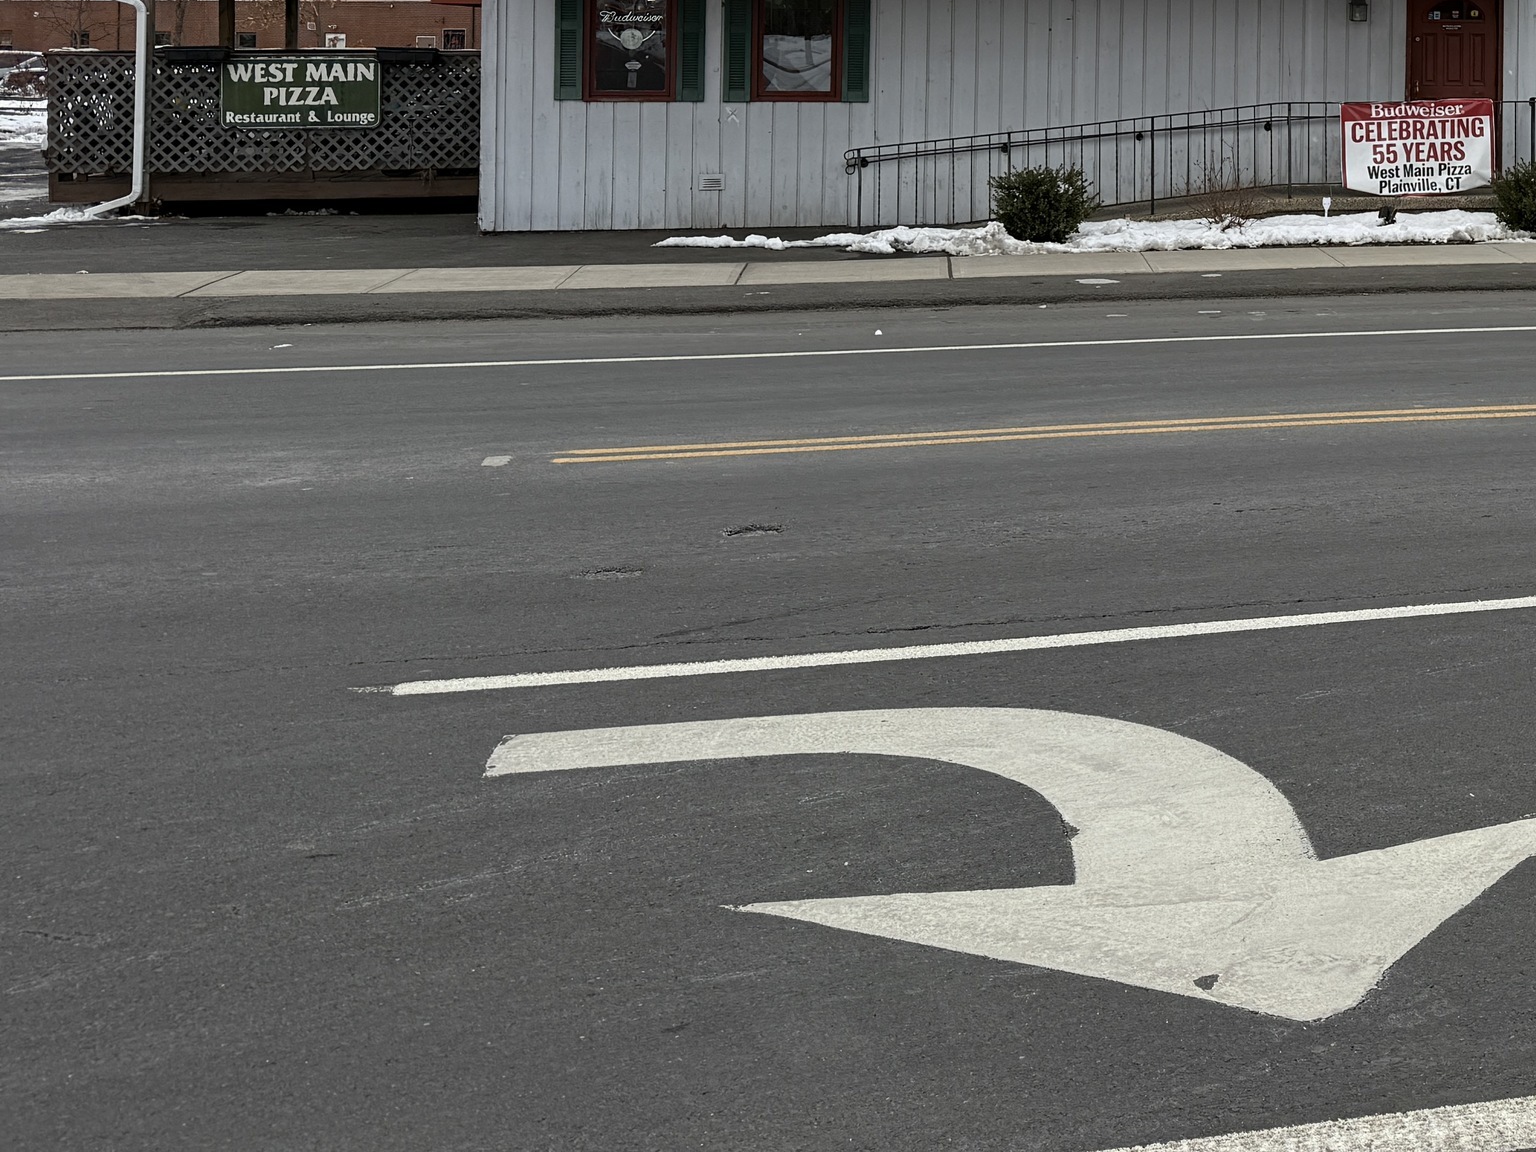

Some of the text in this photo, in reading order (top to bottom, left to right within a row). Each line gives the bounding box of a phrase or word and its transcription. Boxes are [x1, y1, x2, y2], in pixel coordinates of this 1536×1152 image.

[600, 10, 663, 23] Budweiser
[227, 63, 375, 83] WEST MAIN
[263, 87, 339, 106] PIZZA
[226, 110, 375, 125] Restaurant & Lounge
[1370, 103, 1465, 118] Budweiser
[1351, 117, 1485, 143] CELEBRATING
[1372, 140, 1466, 165] 55 YEARS
[1367, 162, 1472, 180] West Main Pizza
[1379, 176, 1462, 194] Plainville, CT
